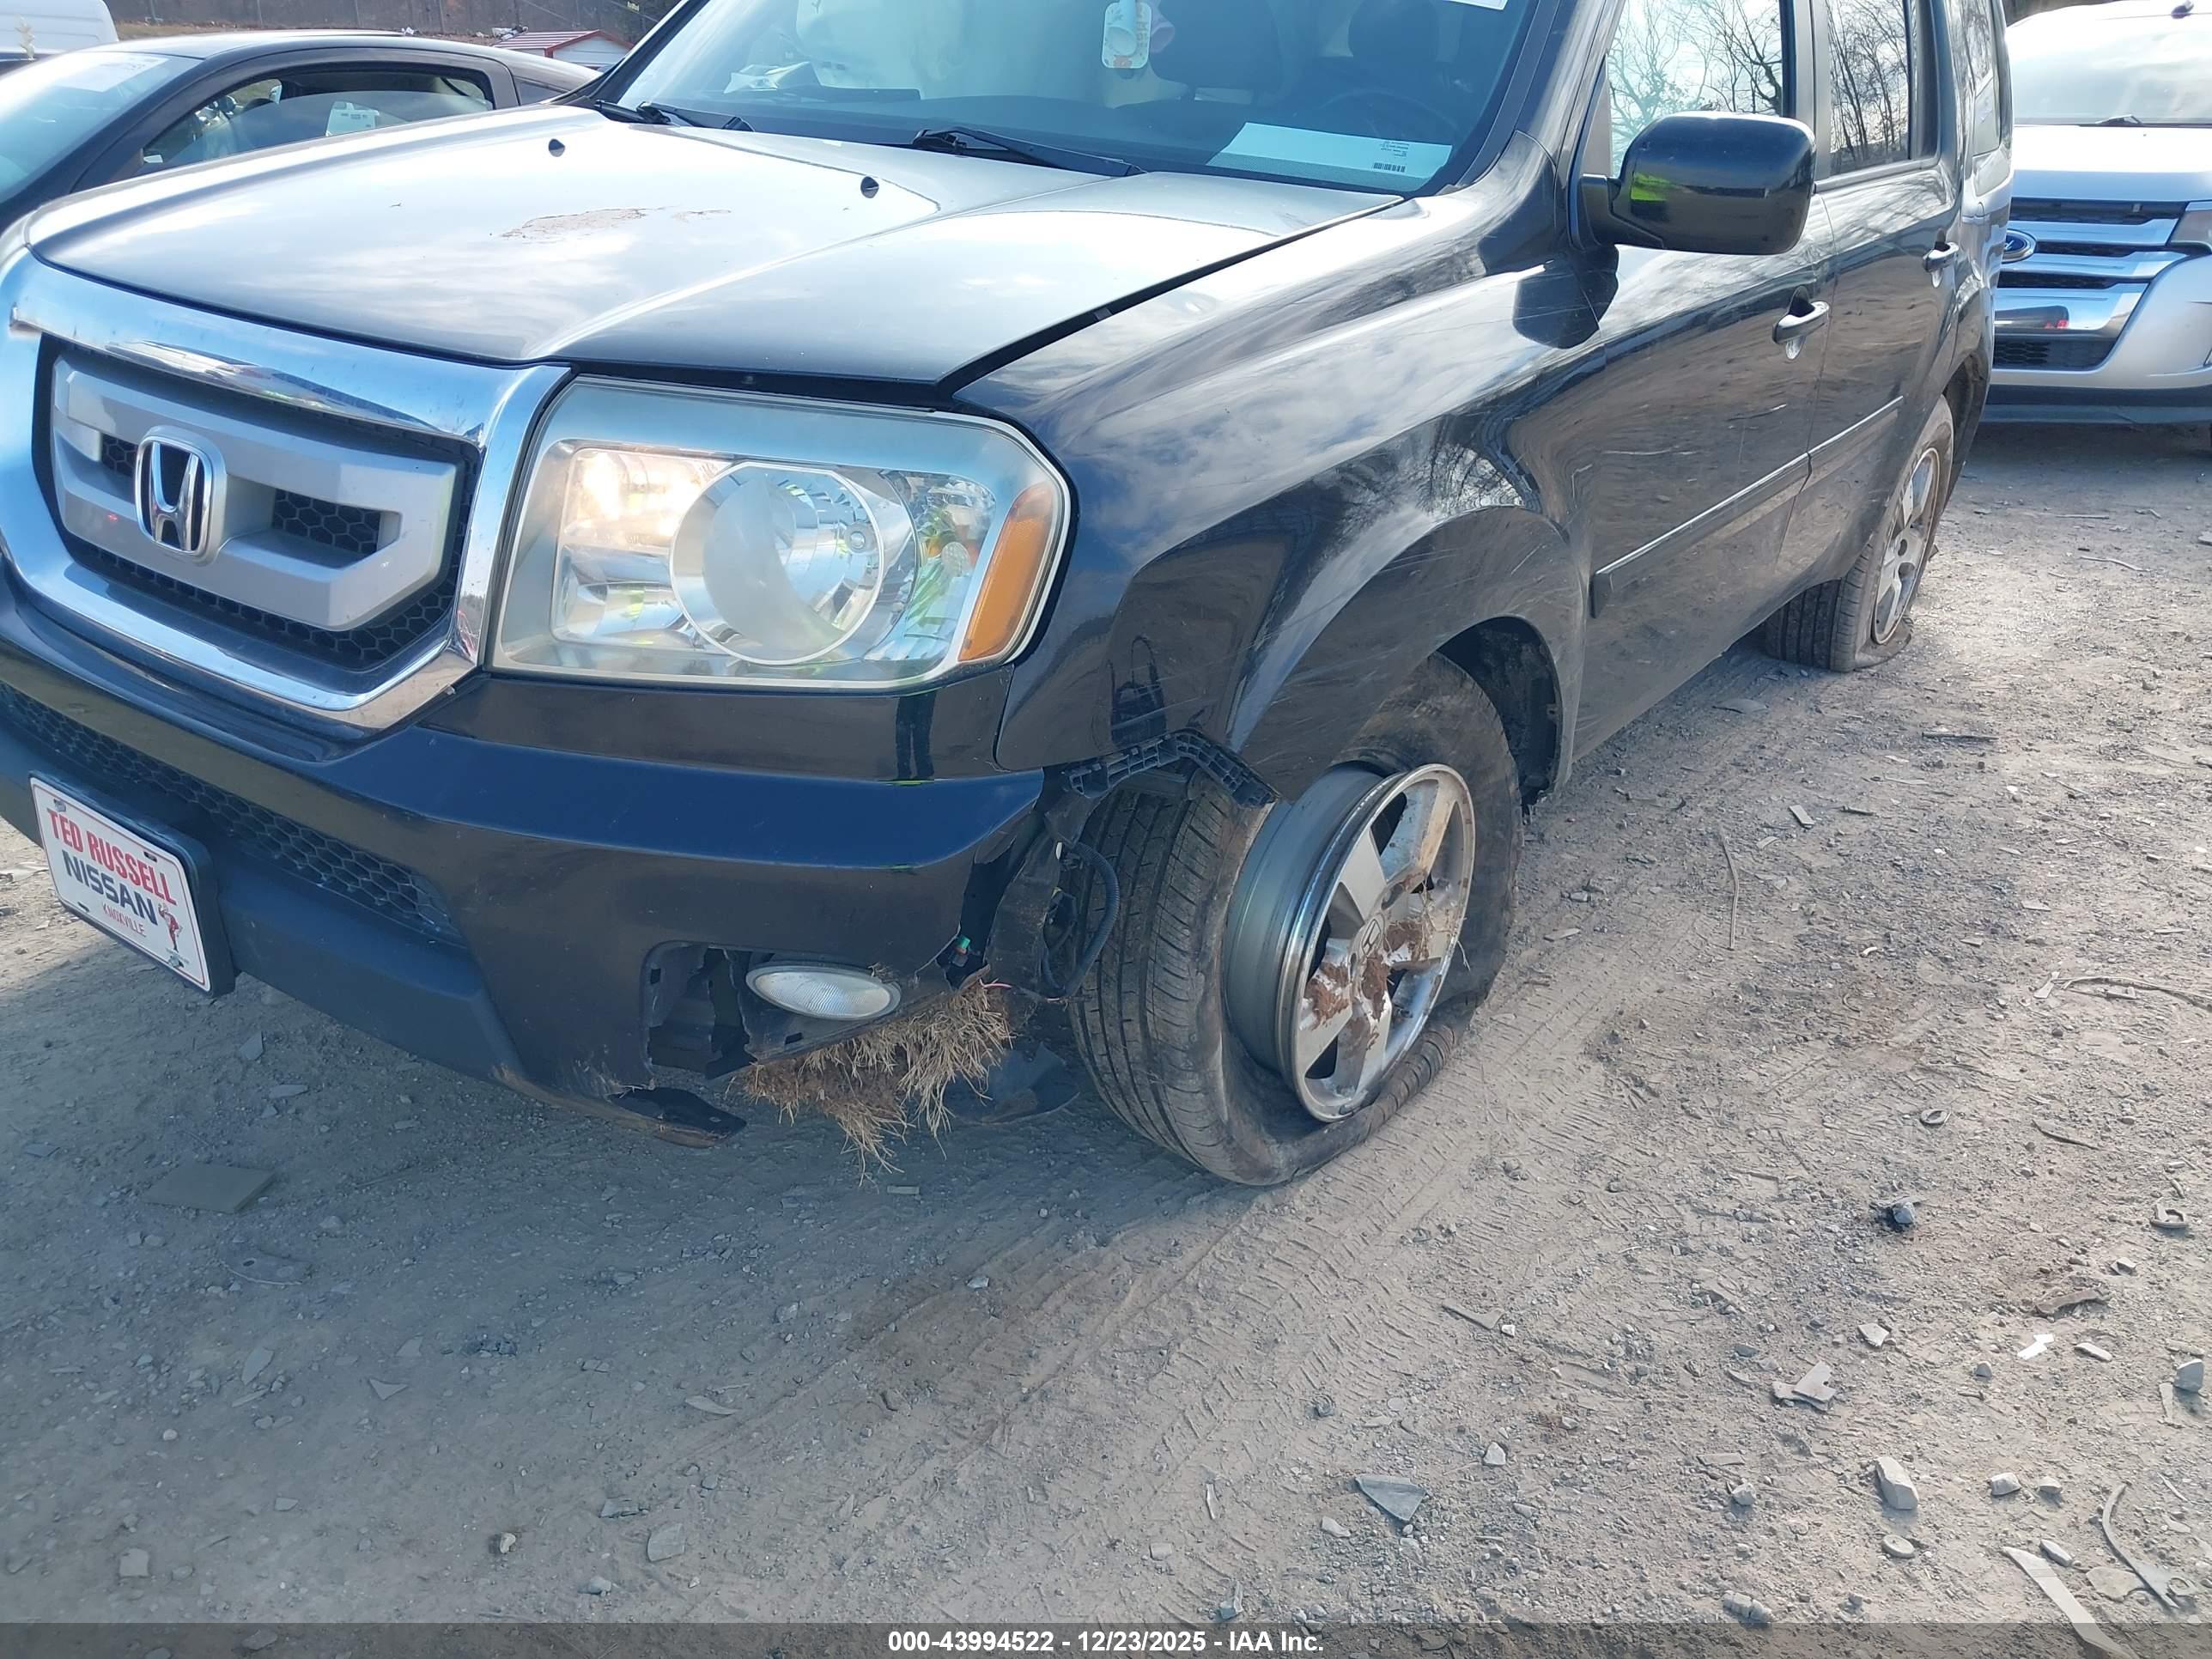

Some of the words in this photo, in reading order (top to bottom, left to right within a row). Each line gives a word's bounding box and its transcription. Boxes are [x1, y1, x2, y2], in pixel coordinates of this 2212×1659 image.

[47, 808, 84, 853] TED
[86, 830, 177, 905] RUSSELL
[62, 849, 158, 926] NISSAN
[102, 902, 146, 939] KNOXVILLE
